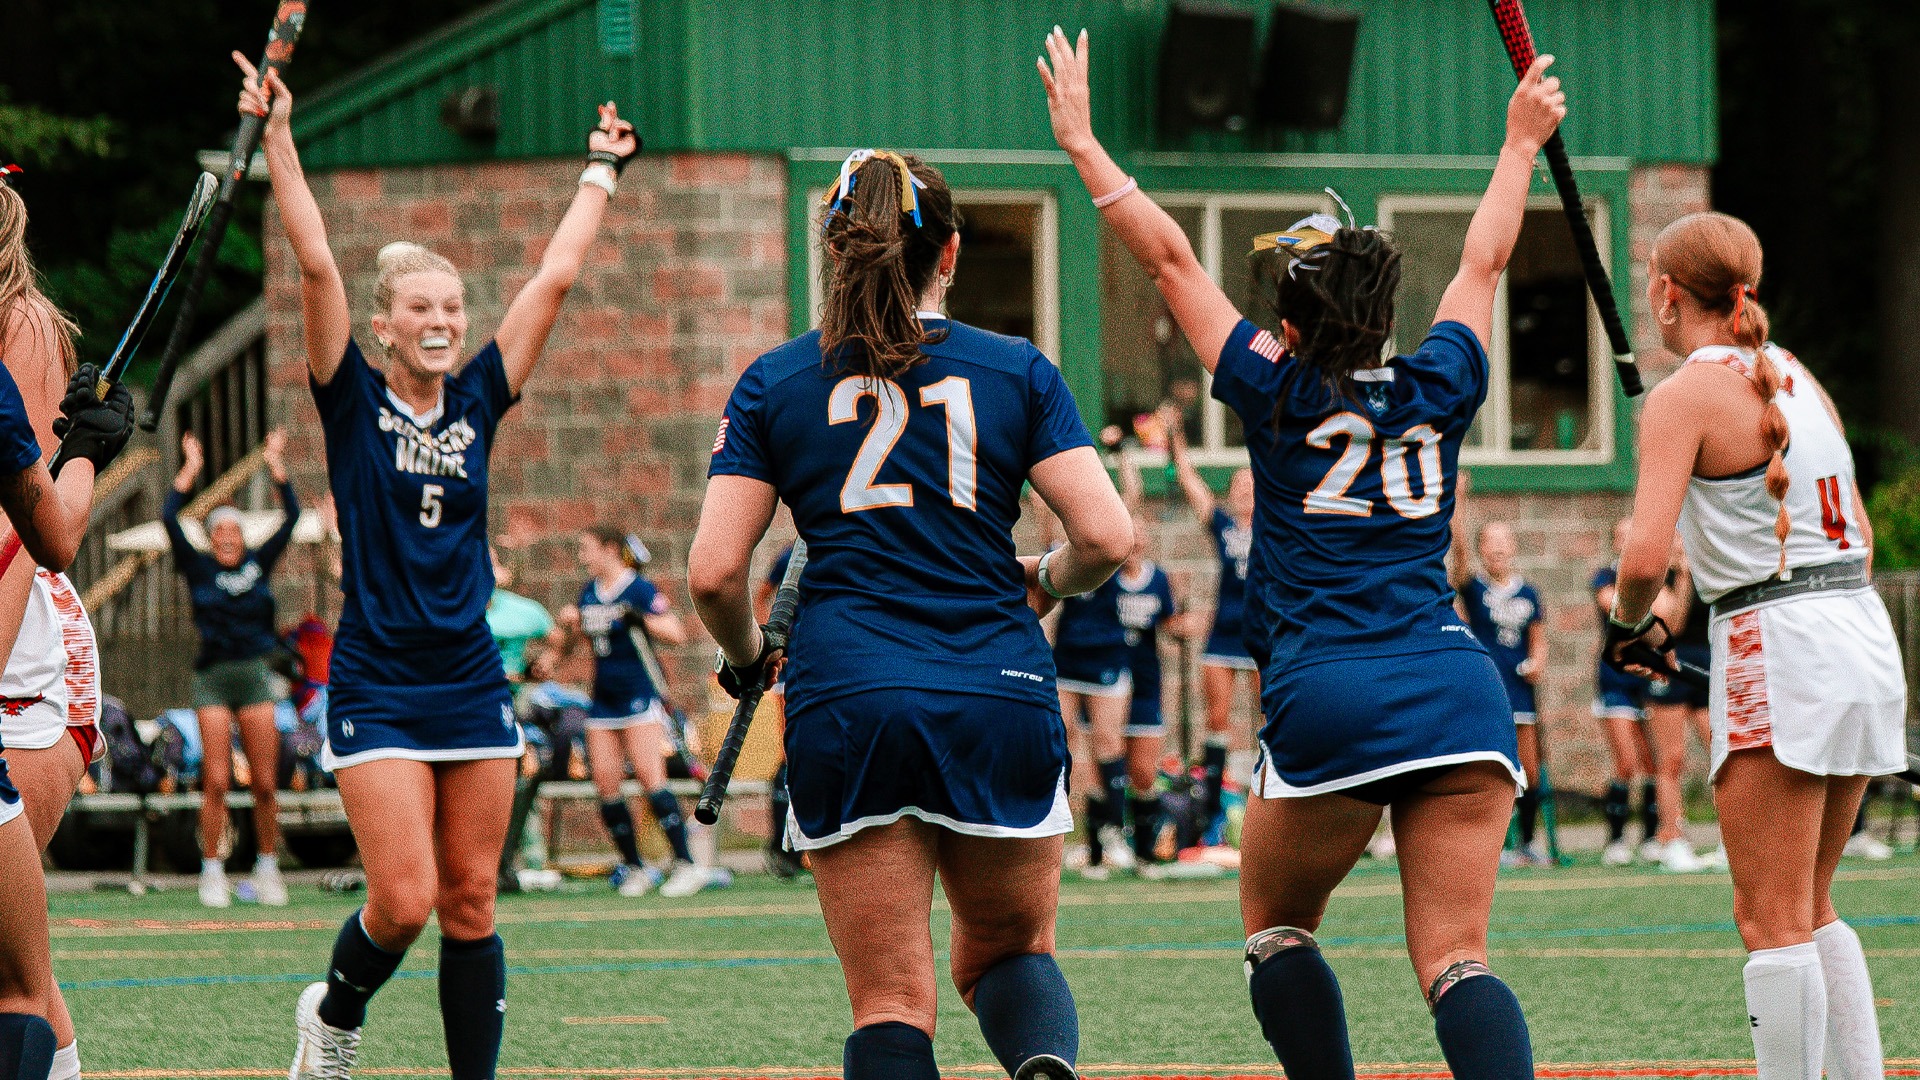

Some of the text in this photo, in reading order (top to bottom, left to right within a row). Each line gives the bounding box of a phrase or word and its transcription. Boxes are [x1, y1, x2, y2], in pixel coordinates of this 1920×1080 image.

[378, 406, 476, 453] SOUTERN
[828, 375, 977, 514] 21
[1303, 411, 1443, 520] 20
[419, 483, 445, 529] 5
[1816, 475, 1850, 550] 4
[1000, 669, 1044, 682] Harrow
